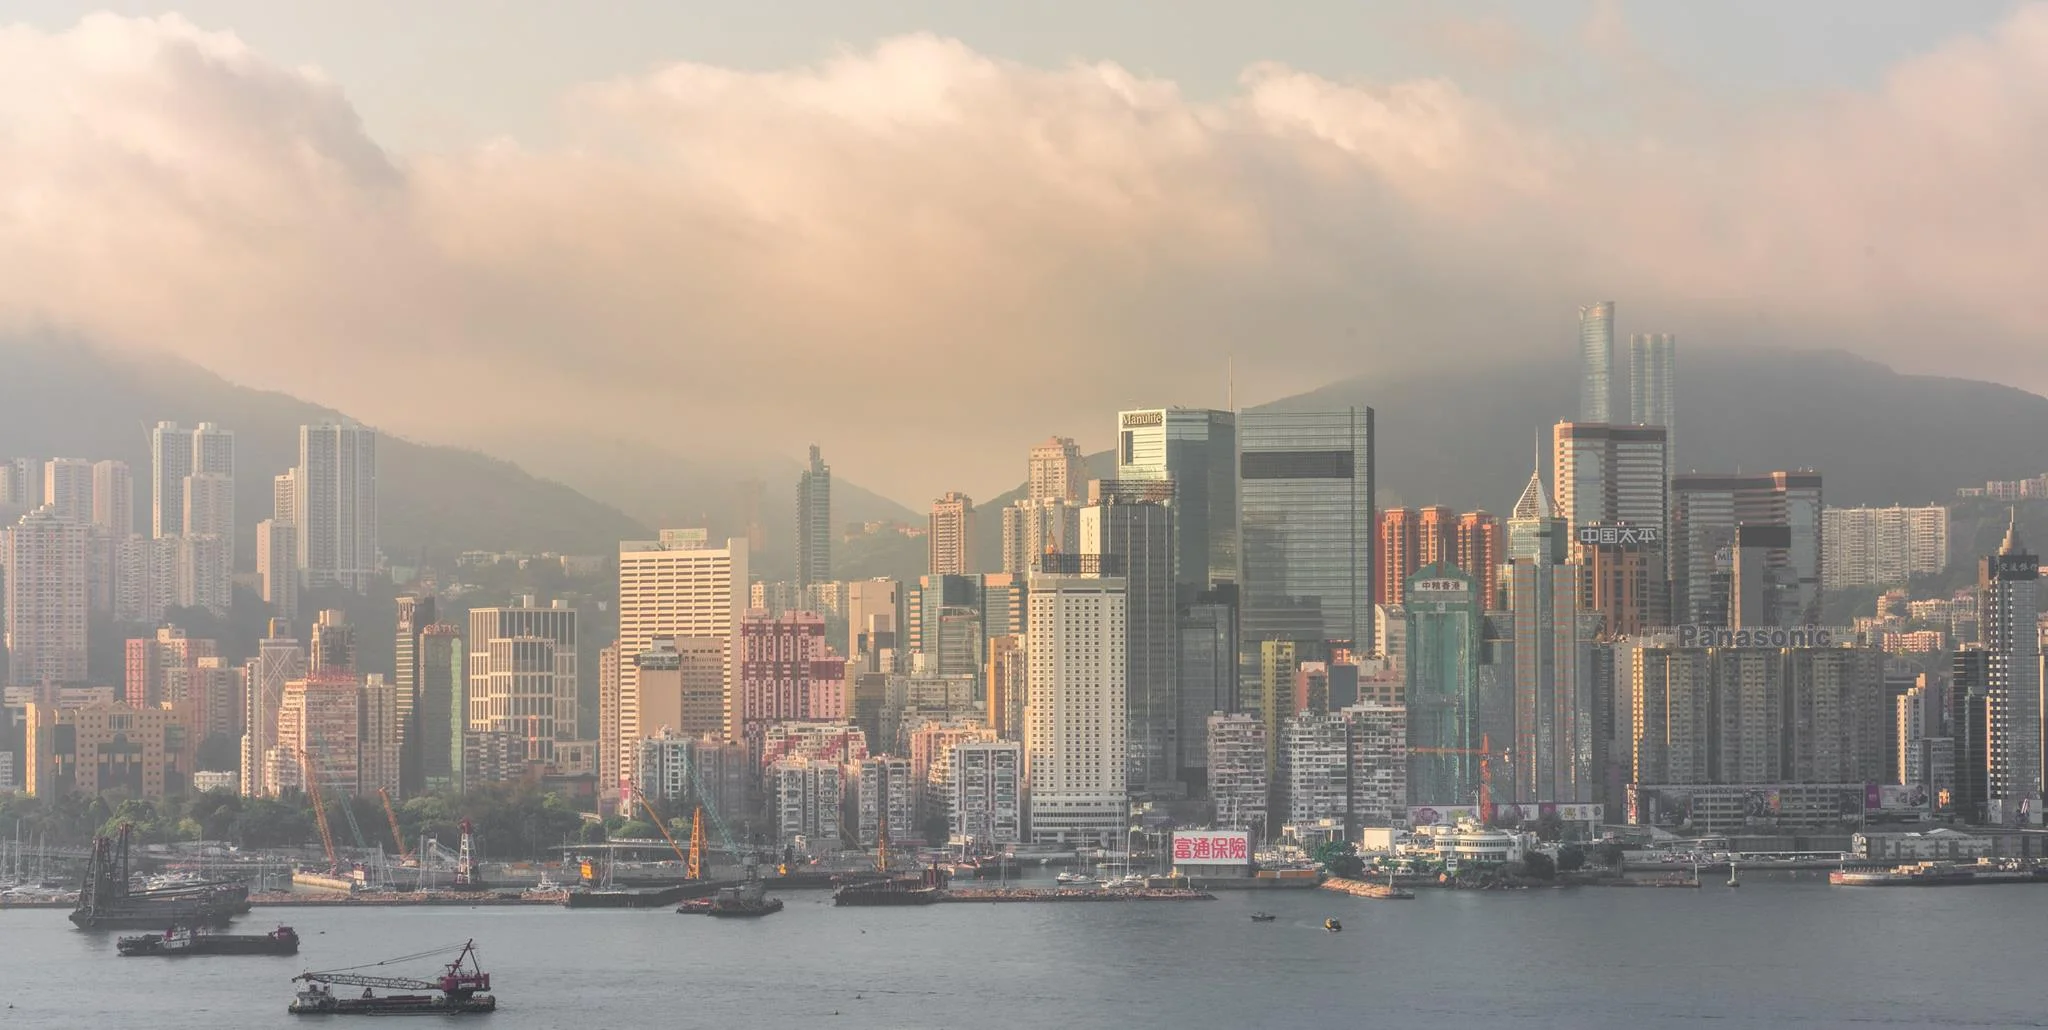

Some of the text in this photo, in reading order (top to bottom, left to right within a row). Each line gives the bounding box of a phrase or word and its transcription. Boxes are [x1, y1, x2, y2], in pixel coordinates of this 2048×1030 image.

[1123, 412, 1162, 424] Manulife
[1581, 527, 1656, 544] 中国太平
[1679, 624, 1831, 648] Panasonic
[1174, 837, 1246, 859] 富通保險
